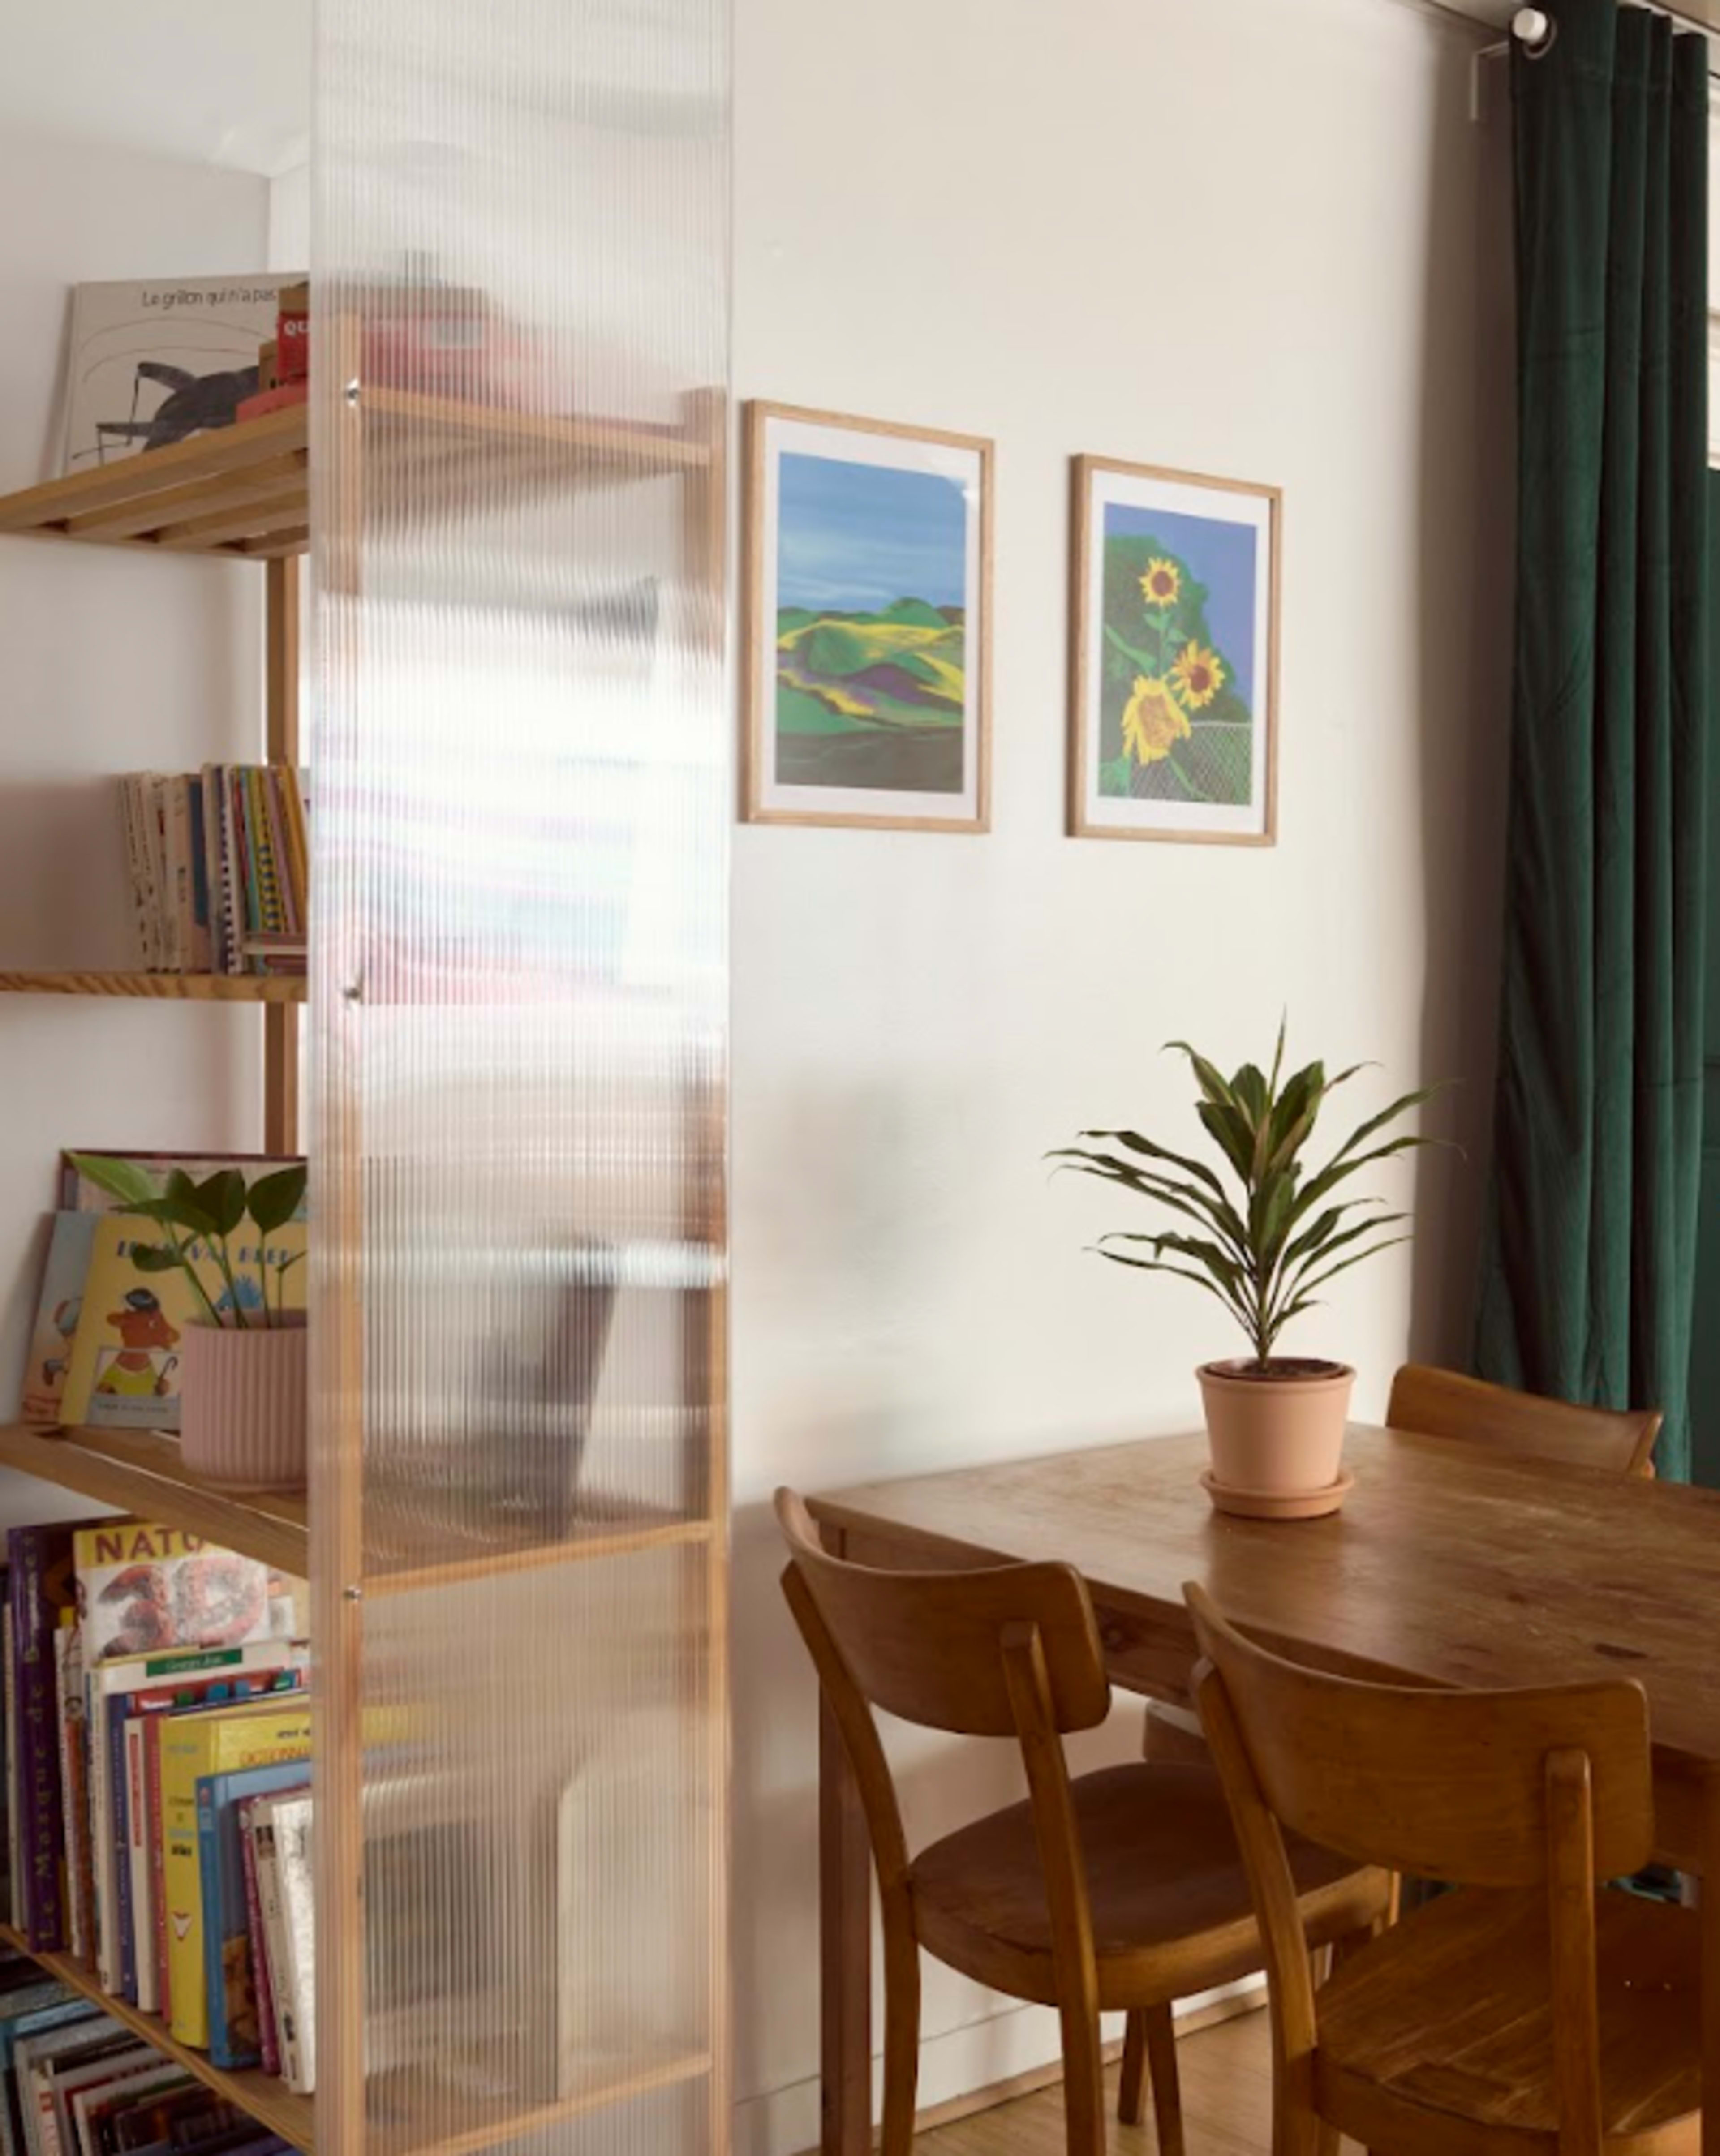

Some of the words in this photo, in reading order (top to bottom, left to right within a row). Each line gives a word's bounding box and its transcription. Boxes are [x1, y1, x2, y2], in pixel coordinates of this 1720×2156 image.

[142, 291, 159, 307] Le
[206, 288, 225, 307] qui
[253, 289, 277, 304] pas
